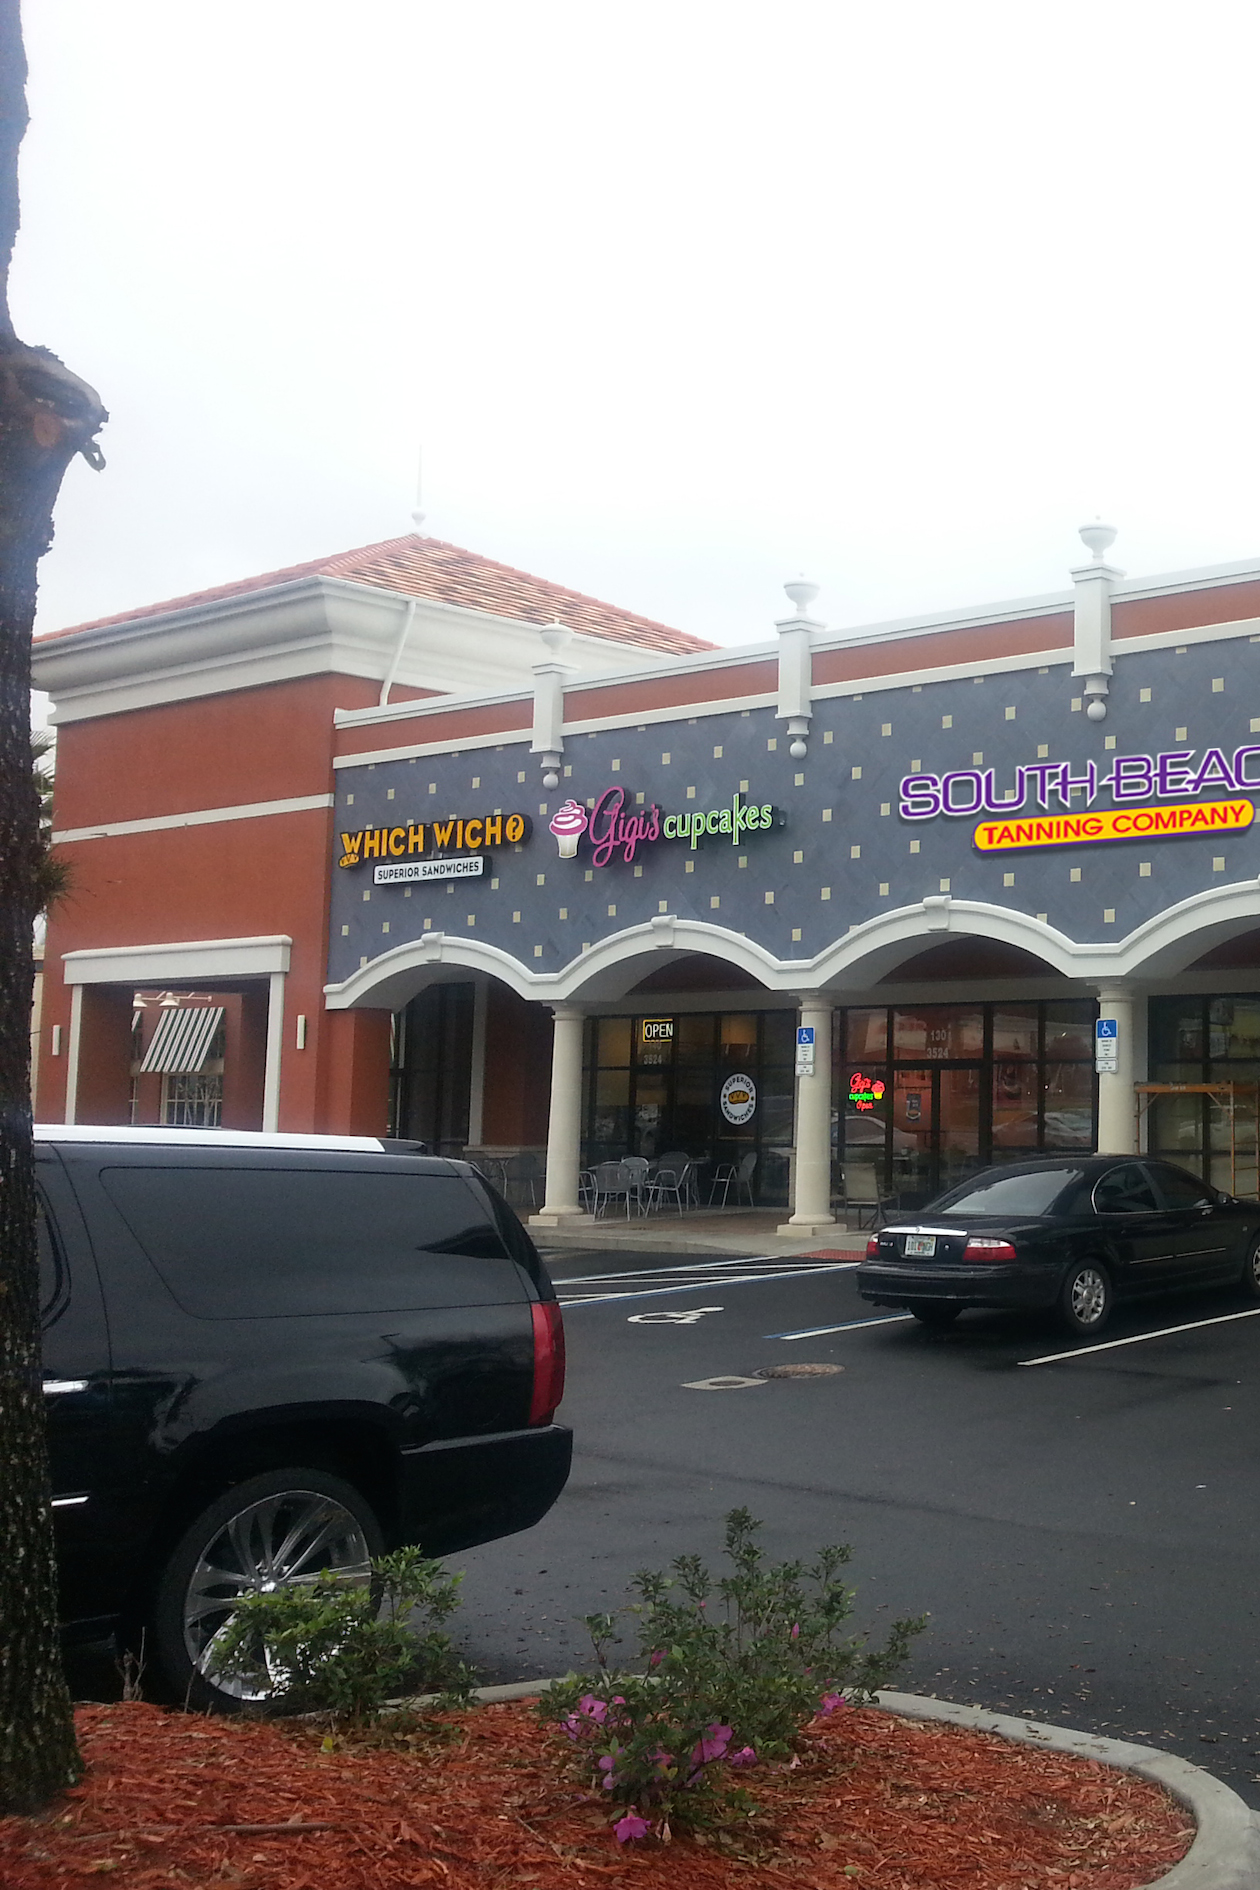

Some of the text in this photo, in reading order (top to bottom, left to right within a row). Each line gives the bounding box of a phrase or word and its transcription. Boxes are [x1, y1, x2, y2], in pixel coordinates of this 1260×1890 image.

[899, 759, 1098, 820] SOUTH
[589, 786, 773, 867] Gigi's cupcakes
[982, 803, 1248, 846] TANNING COMPANY
[341, 824, 425, 859] WHICH
[377, 861, 480, 881] SUPERIOR SANDWICHES
[645, 1023, 674, 1038] OPEN
[930, 1029, 947, 1041] 130
[926, 1047, 949, 1059] 3524
[725, 1076, 754, 1093] SUPERIOR
[723, 1101, 754, 1121] SANDWICHES
